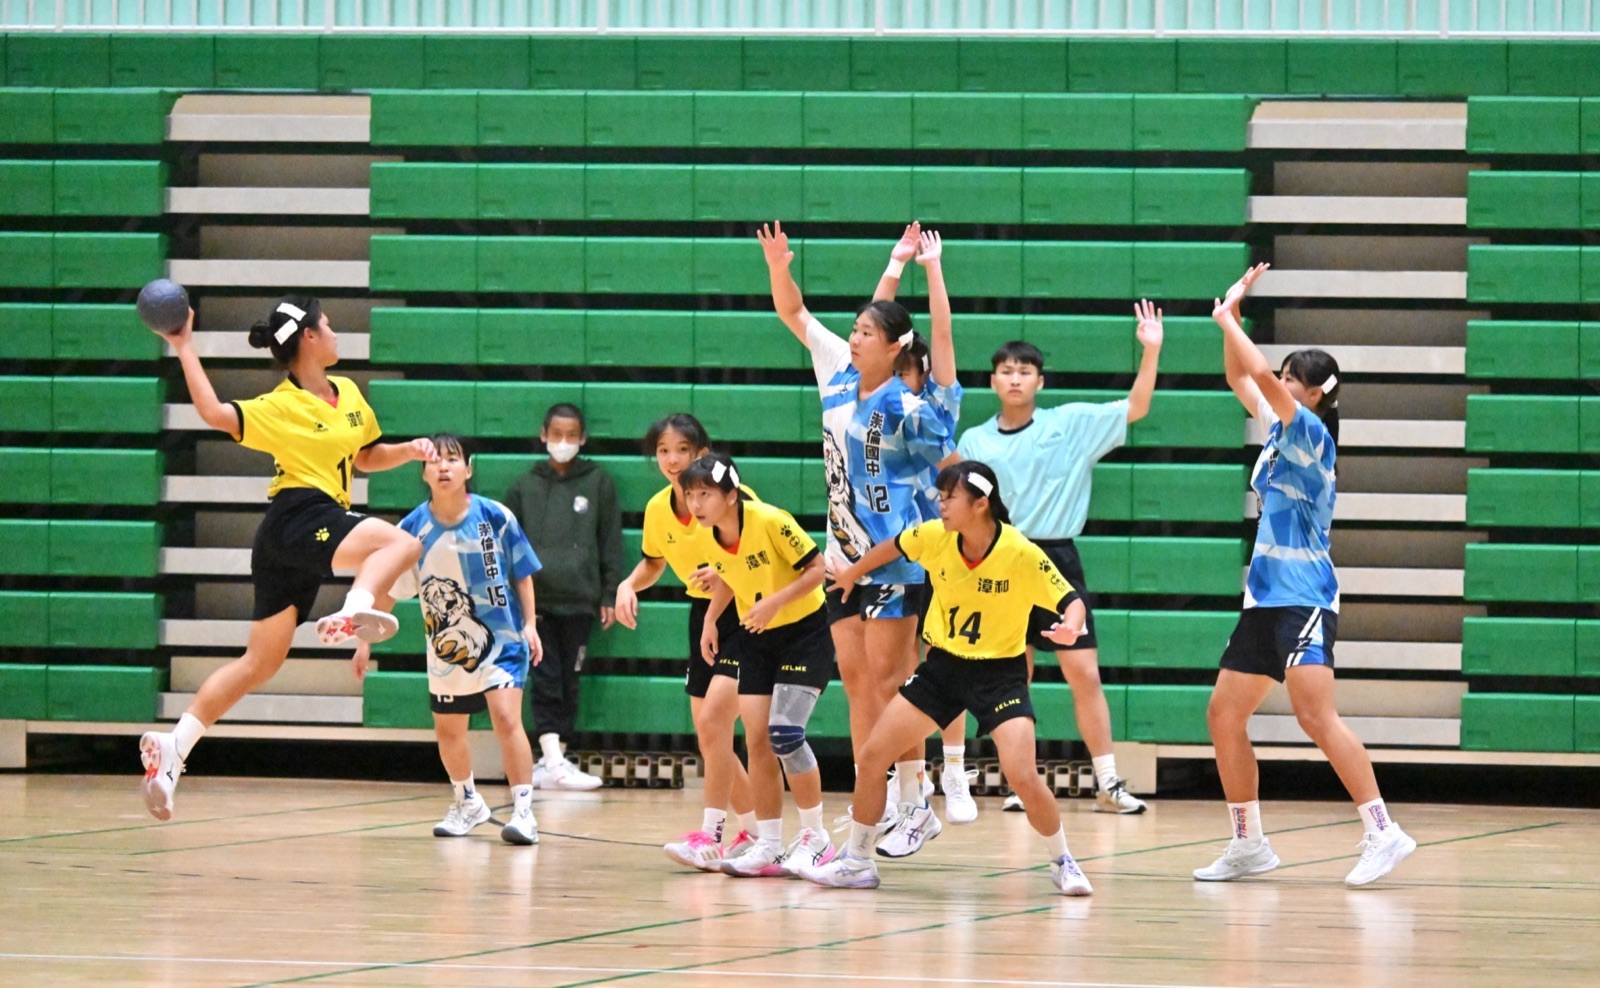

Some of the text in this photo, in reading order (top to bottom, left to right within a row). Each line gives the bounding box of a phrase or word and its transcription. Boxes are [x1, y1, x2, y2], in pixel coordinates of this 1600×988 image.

[866, 411, 884, 477] 崇倫國中
[865, 485, 890, 513] 12
[478, 522, 499, 580] 崇倫國中
[486, 585, 508, 607] 15
[977, 577, 1010, 594] 漳和
[947, 605, 982, 645] 14
[994, 698, 1021, 713] KELME
